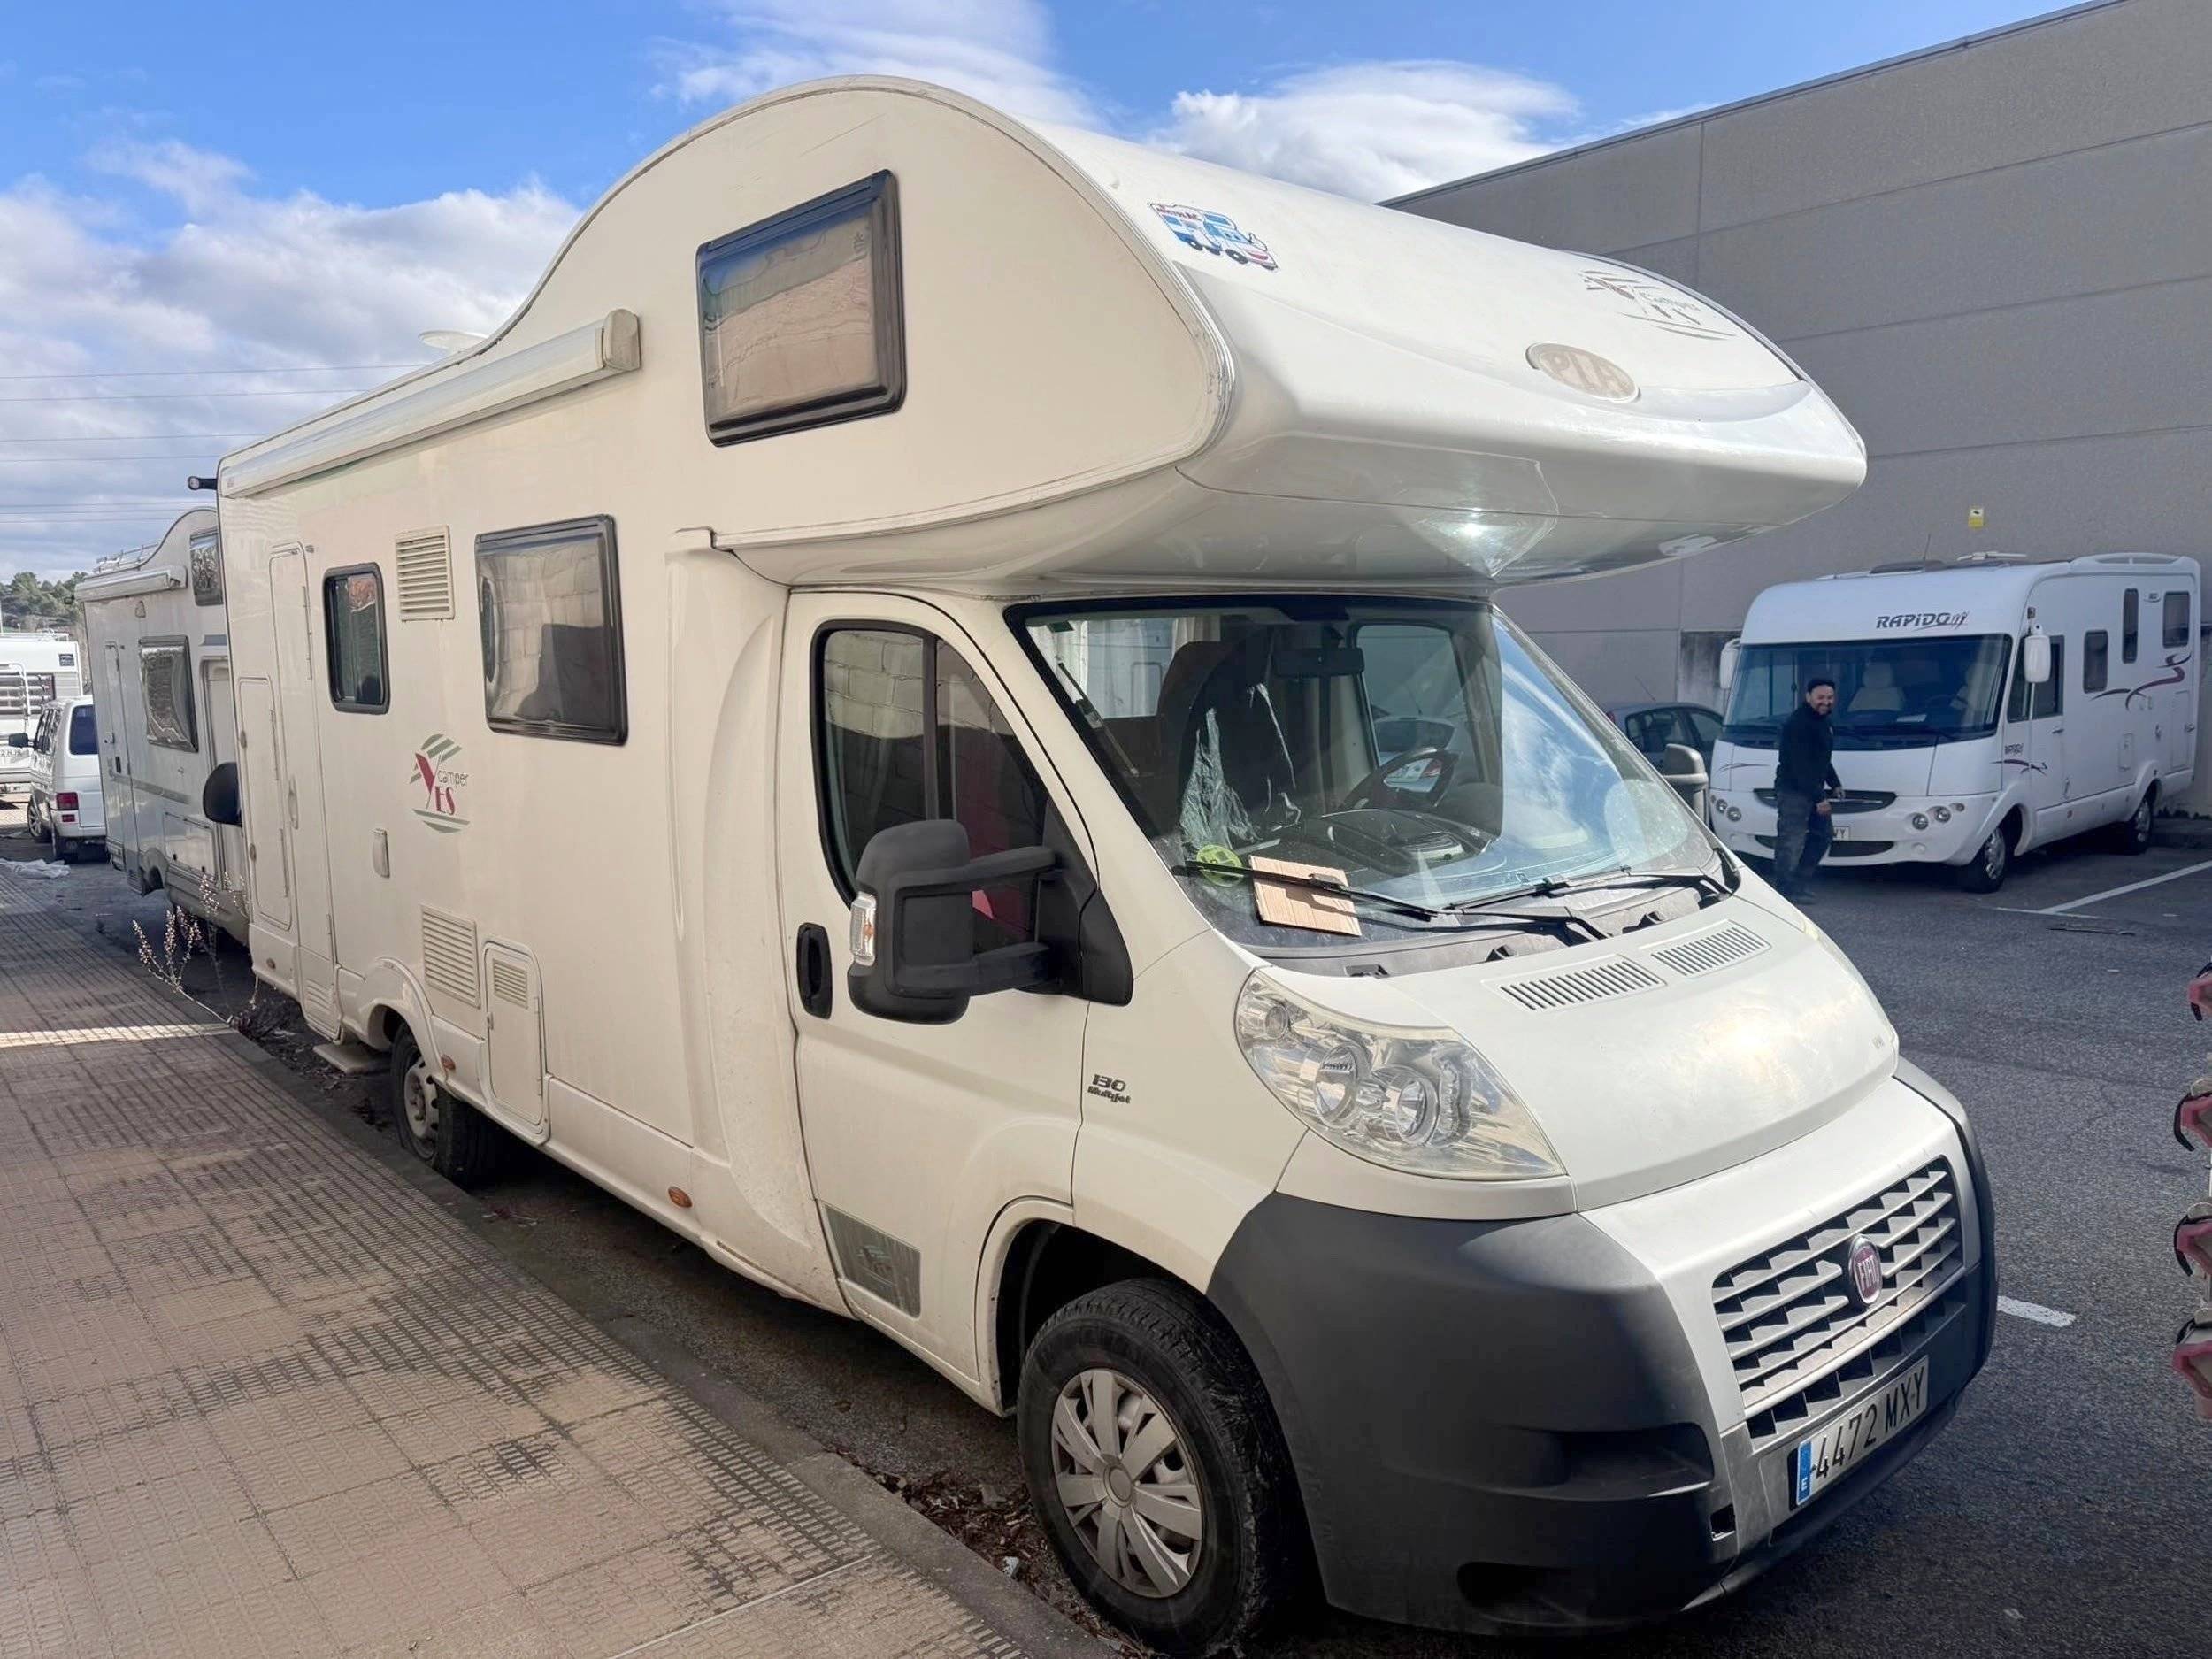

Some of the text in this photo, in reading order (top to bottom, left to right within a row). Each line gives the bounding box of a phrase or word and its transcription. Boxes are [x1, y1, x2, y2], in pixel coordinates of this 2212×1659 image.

[437, 770, 469, 787] camper
[1092, 1073, 1126, 1092] 130
[1816, 1403, 1877, 1479] 4472
[1885, 1365, 1924, 1434] MXY
